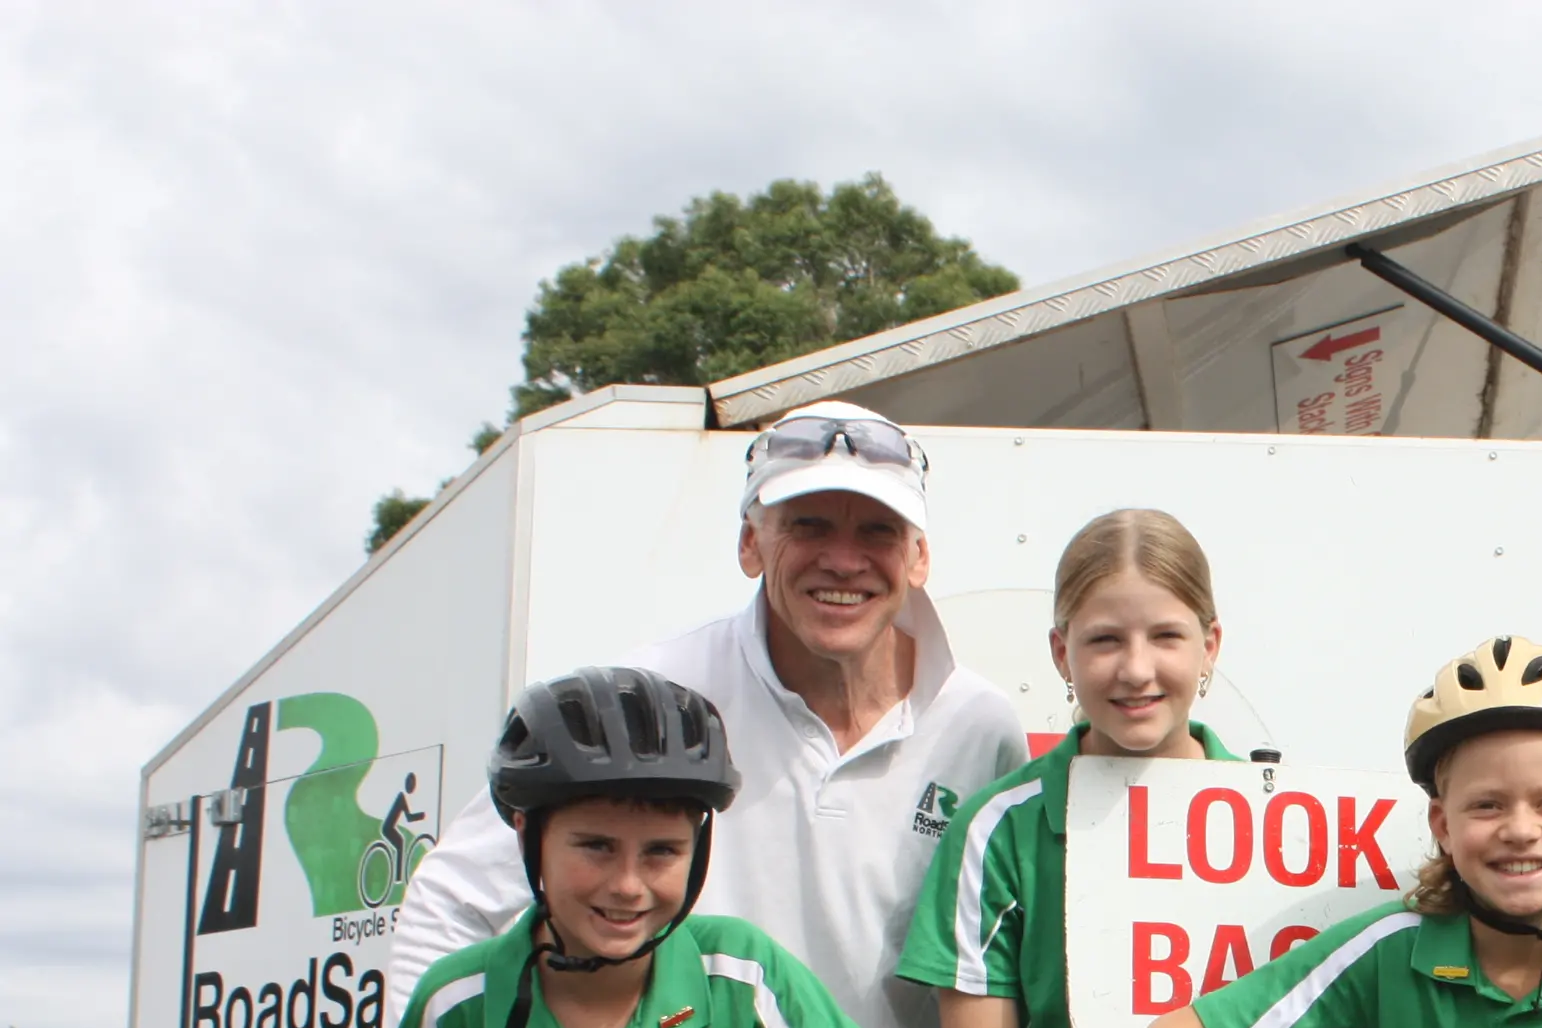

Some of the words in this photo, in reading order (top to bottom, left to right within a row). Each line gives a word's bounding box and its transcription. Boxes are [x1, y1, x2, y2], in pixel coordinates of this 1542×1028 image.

[1334, 350, 1384, 397] Signs
[1345, 393, 1381, 433] With
[912, 824, 943, 839] NORTH
[1128, 786, 1400, 890] LOOK
[332, 912, 386, 946] Bicycle
